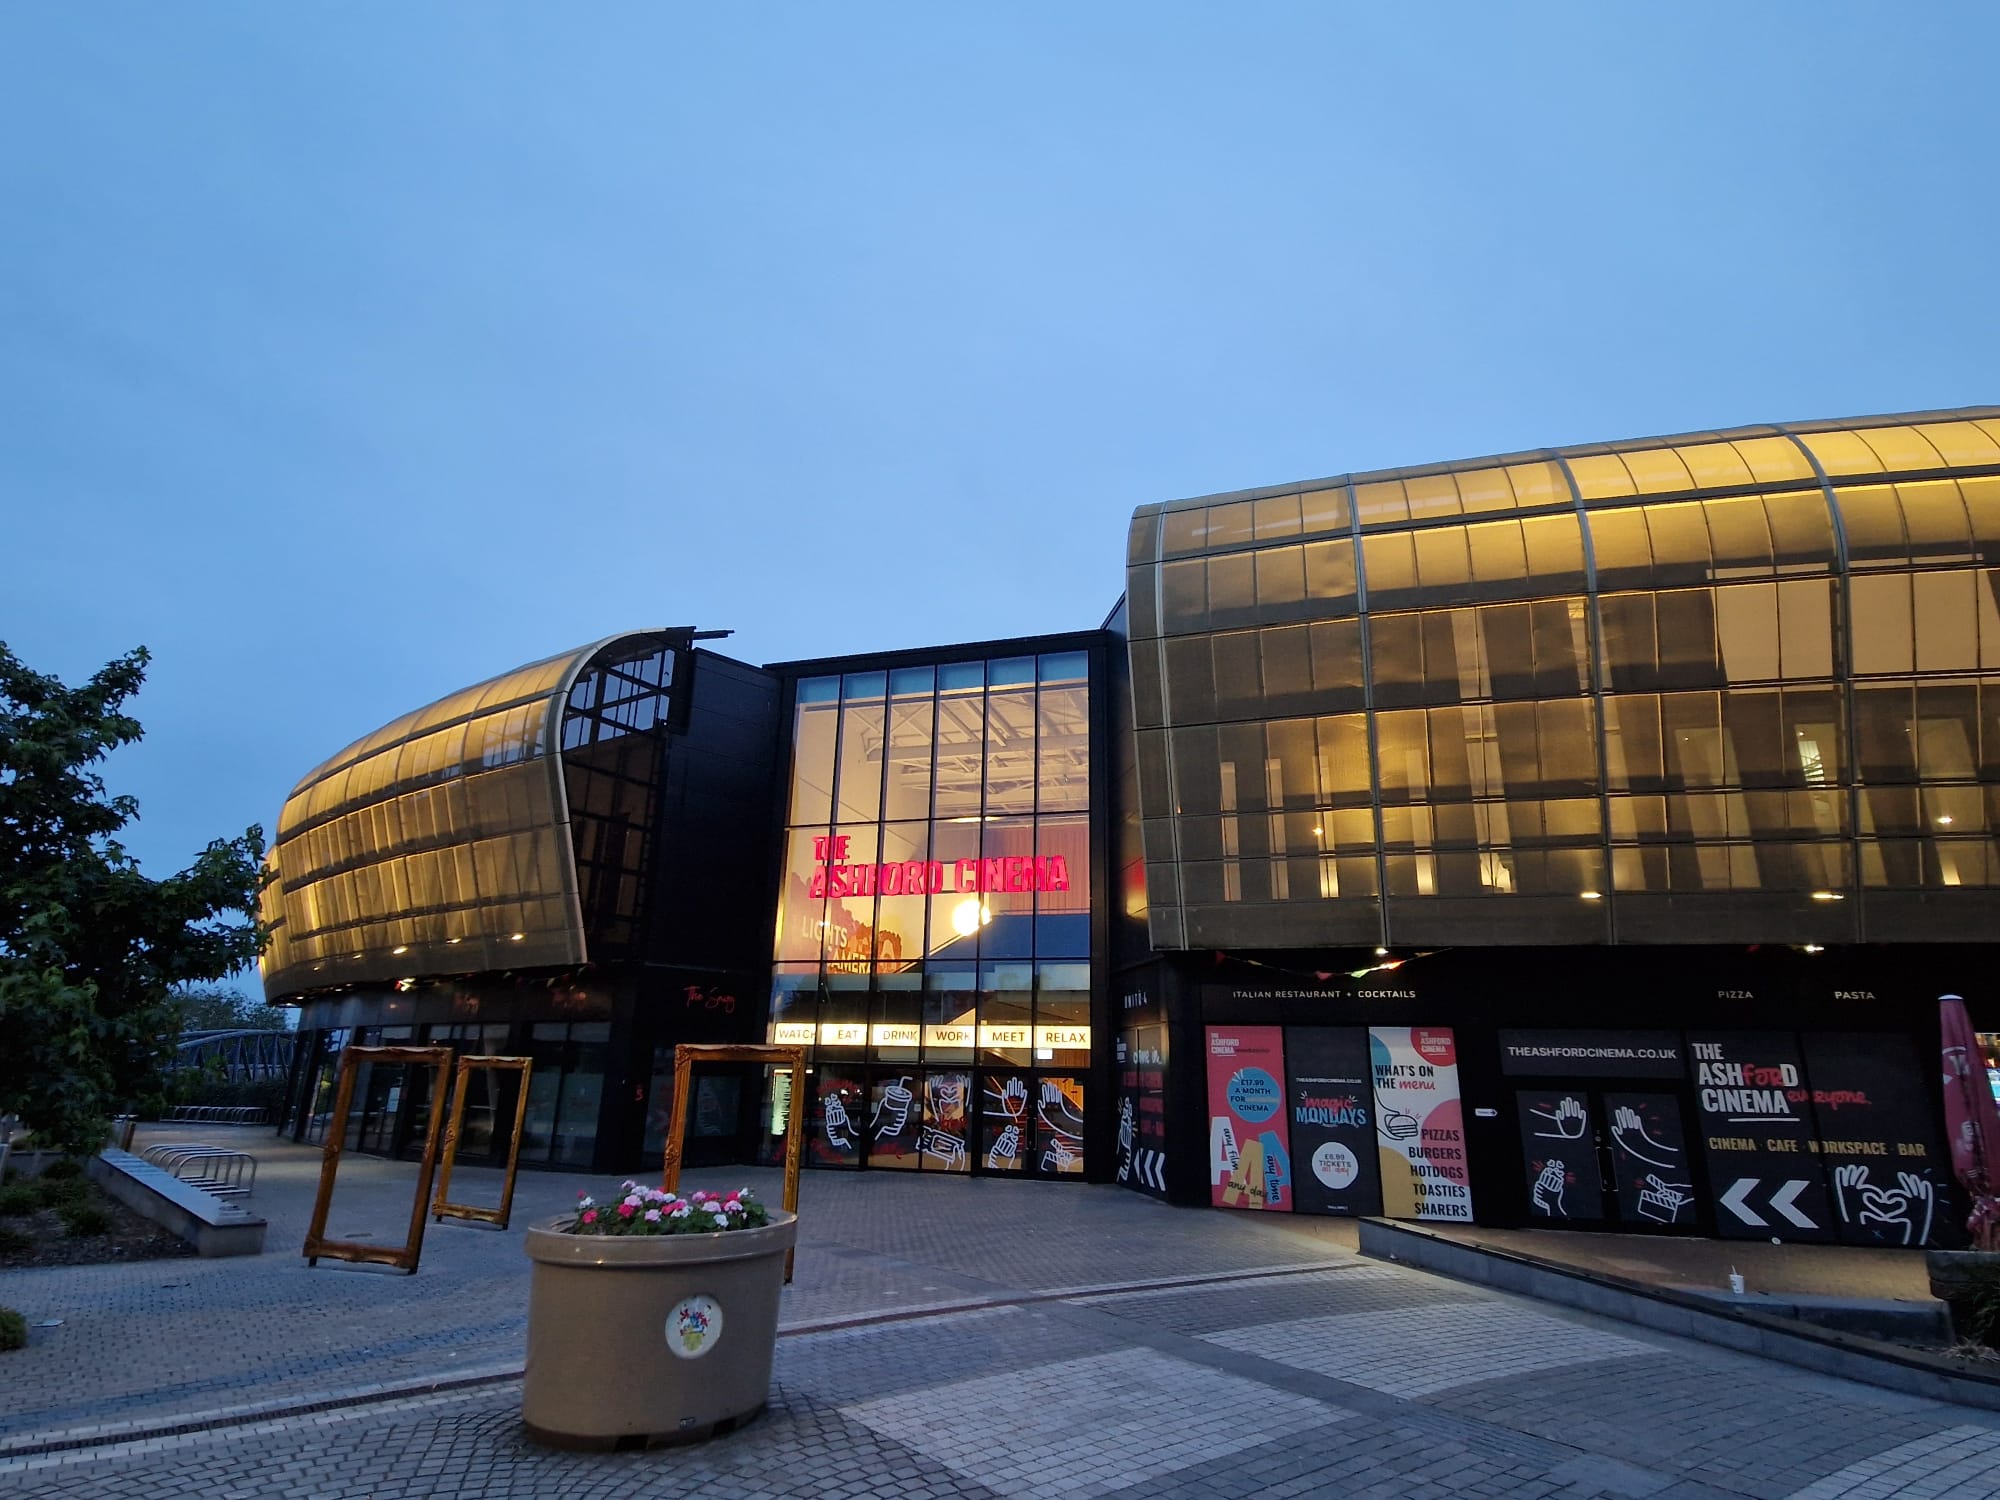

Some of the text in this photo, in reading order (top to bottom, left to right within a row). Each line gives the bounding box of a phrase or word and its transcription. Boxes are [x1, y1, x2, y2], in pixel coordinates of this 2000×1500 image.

[811, 836, 850, 861] THE
[809, 855, 1070, 898] ASHFORD CINEMA
[802, 915, 848, 947] LIGHTS
[1232, 990, 1272, 999] ITALIAN
[1275, 990, 1341, 999] RESTAURANT
[1357, 990, 1417, 999] COCKTAILS
[1717, 990, 1754, 999] PIZZA
[1834, 990, 1876, 1000] PASTA
[778, 1029, 816, 1039] WATCH
[838, 1030, 858, 1039] EAT
[883, 1030, 918, 1040] DRINK
[936, 1031, 971, 1041] WORK
[992, 1031, 1026, 1042] MEET
[1046, 1032, 1086, 1043] RELAX
[1506, 1045, 1677, 1060] THEASHFORDCINEMA.CO.UK
[1692, 1042, 1725, 1060] THE
[1375, 1065, 1434, 1078] WHAT'S ON
[1376, 1077, 1436, 1091] THE menu
[1242, 1087, 1271, 1095] MONTH
[1230, 1095, 1246, 1103] FOR
[1701, 1088, 1791, 1114] CINEMA
[1238, 1104, 1269, 1112] CINEMA
[1296, 1107, 1367, 1125] MONDAYS
[1421, 1128, 1460, 1141] PIZZAS
[1408, 1146, 1462, 1160] BURGERS
[1708, 1136, 1758, 1152] CINEMA
[1766, 1138, 1799, 1153] CAFE
[1896, 1142, 1927, 1157] BAR
[1319, 1160, 1352, 1169] TICKETS
[1410, 1165, 1464, 1179] HOTDOGS
[1413, 1183, 1466, 1198] TOASTIES
[1414, 1202, 1468, 1217] SHARERS
